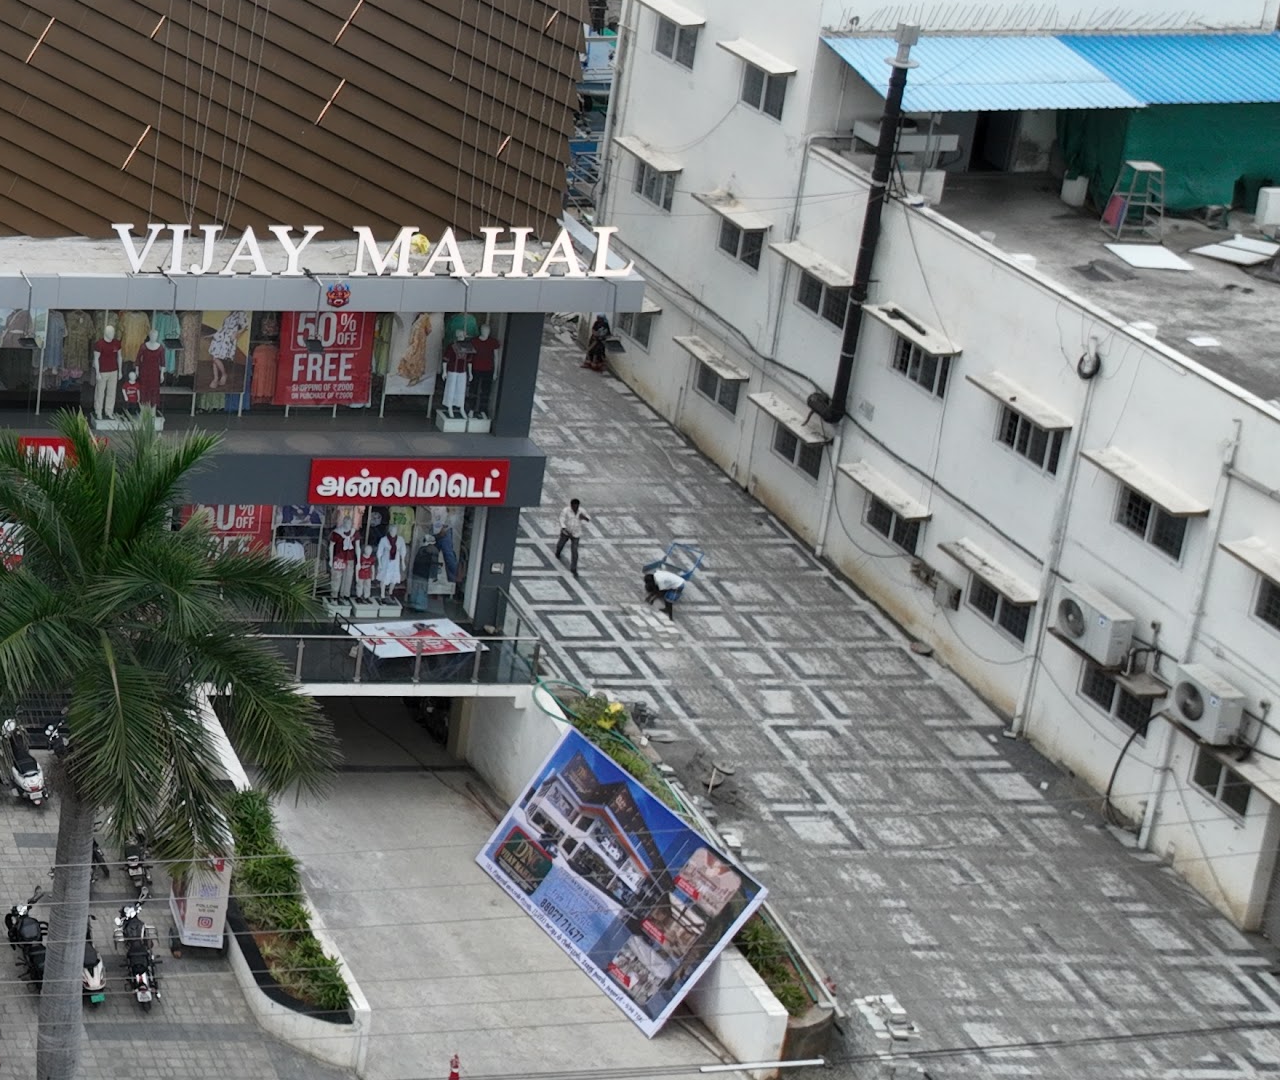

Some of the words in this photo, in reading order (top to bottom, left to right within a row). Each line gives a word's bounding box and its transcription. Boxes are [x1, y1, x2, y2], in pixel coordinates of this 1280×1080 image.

[111, 223, 323, 275] VIJAY
[351, 226, 635, 278] MAHAL
[337, 333, 357, 346] OFF
[292, 353, 355, 382] FREE
[235, 516, 256, 529] OFF
[512, 838, 545, 874] DNC
[538, 896, 564, 924] 88077
[559, 917, 584, 944] 71477
